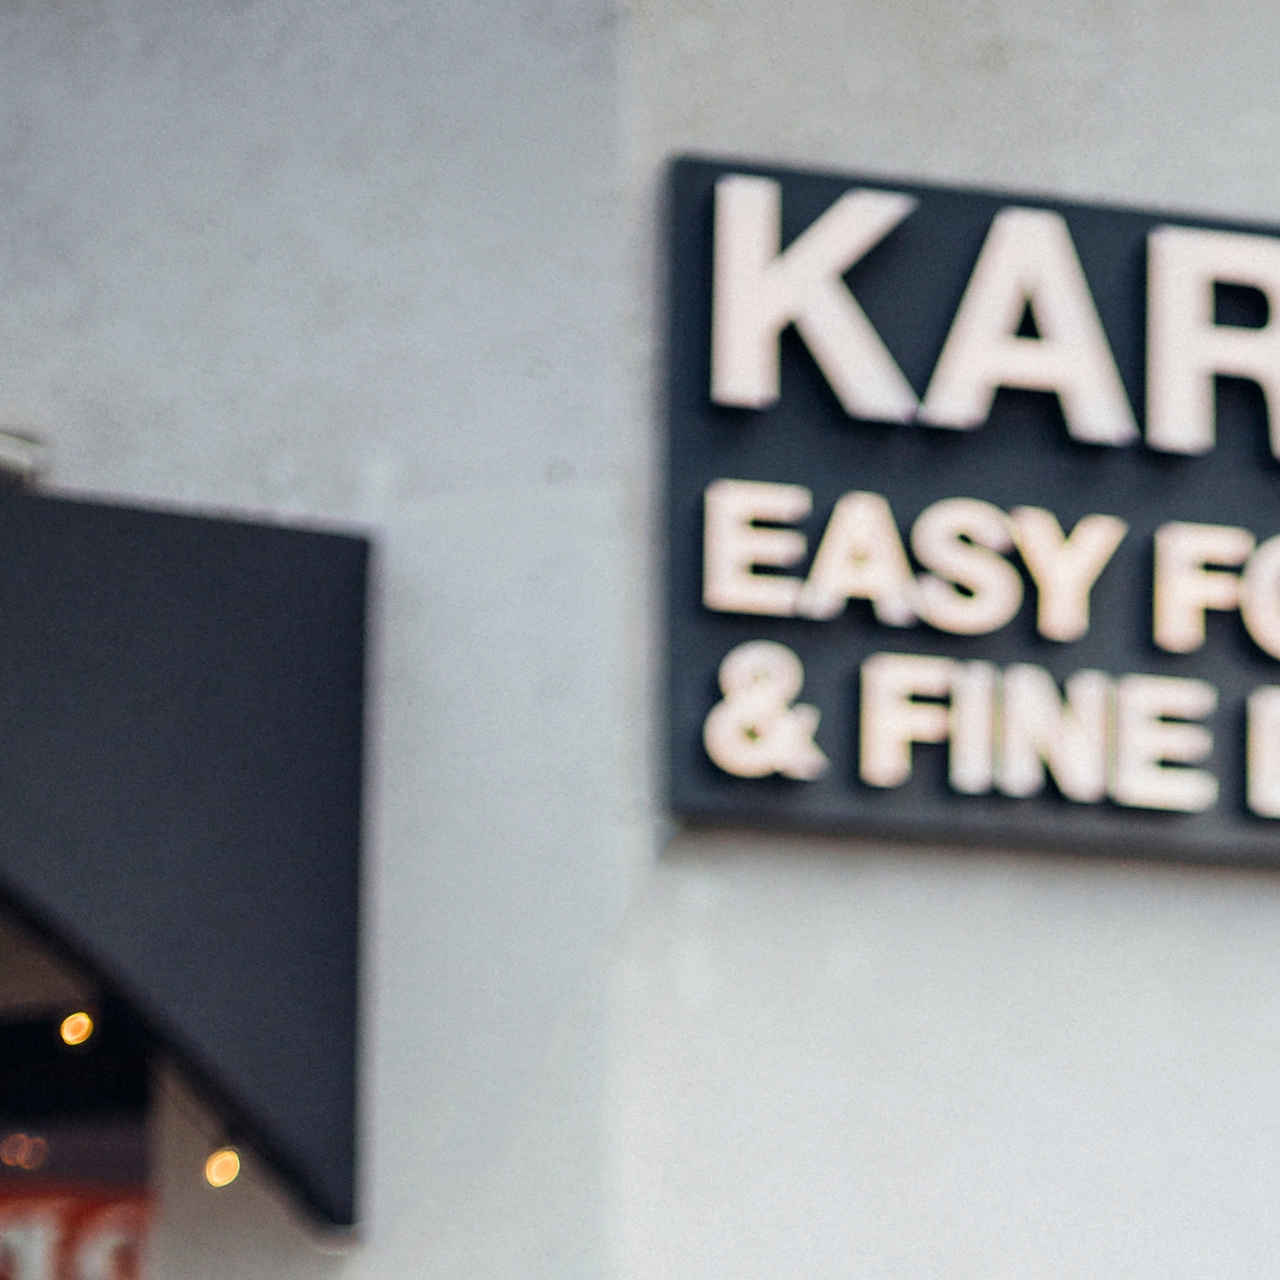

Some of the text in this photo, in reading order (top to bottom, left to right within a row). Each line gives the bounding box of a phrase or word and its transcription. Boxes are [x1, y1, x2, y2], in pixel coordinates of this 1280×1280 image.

[702, 477, 1129, 643] EASY
[703, 640, 828, 781] &
[859, 651, 1219, 813] FINE
